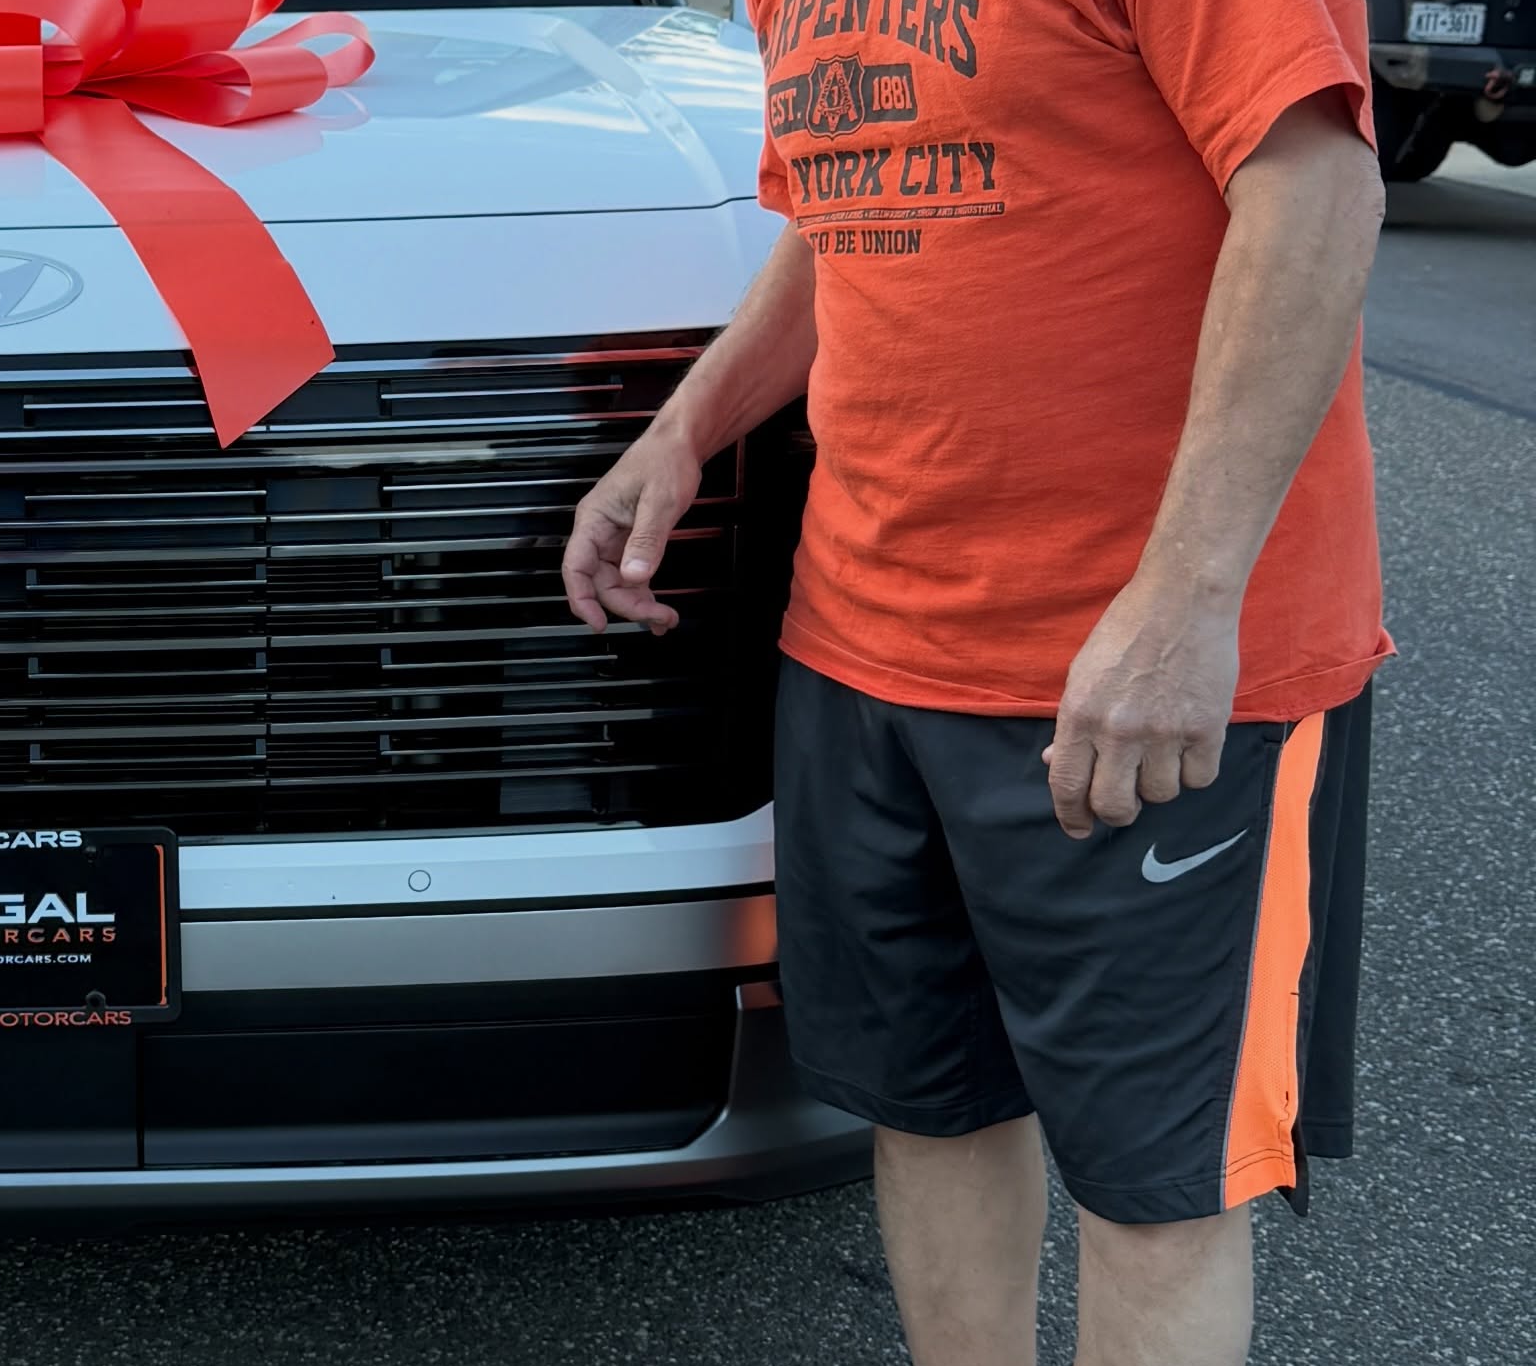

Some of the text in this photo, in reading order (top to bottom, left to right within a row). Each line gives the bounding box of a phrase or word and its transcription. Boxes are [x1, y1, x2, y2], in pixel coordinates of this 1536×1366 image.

[770, 88, 802, 127] EST.
[872, 75, 913, 111] 1881
[791, 142, 996, 203] YORK CITY
[809, 229, 922, 254] TO BE UNION
